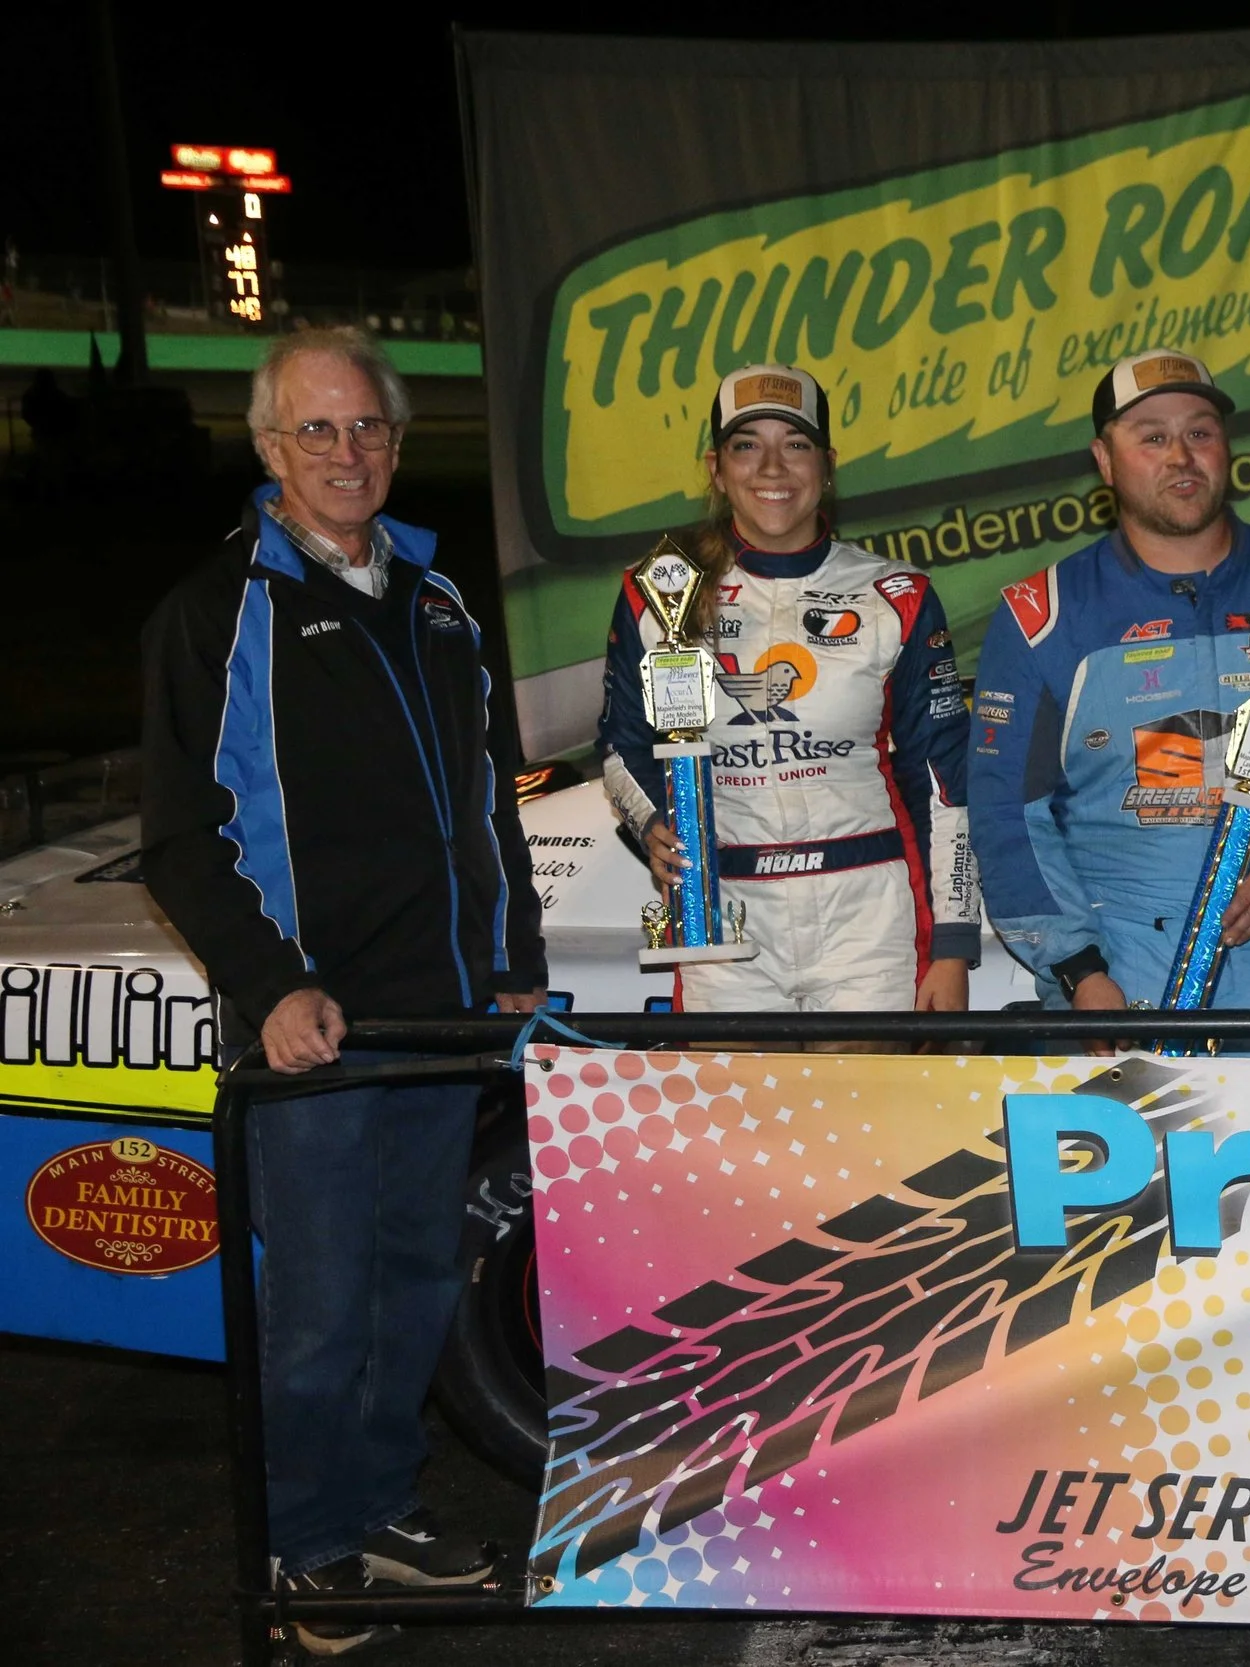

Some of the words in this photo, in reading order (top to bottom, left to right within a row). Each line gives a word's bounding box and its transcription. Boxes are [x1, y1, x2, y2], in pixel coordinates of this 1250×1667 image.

[588, 205, 1066, 408] THUNDER
[988, 317, 1036, 427] of
[1120, 618, 1174, 643] ACT
[660, 719, 676, 728] 3rd
[678, 718, 702, 727] Place
[713, 729, 856, 769] astRise
[715, 773, 767, 787] CREDIT
[778, 766, 828, 782] UNION
[1237, 766, 1250, 777] 1st
[527, 834, 597, 848] Owners:
[755, 851, 824, 874] HOAR
[948, 832, 967, 902] Laplante's
[117, 1141, 151, 1158] 152
[48, 1150, 105, 1179] MAIN
[157, 1155, 217, 1195] STREET
[76, 1181, 188, 1212] FAMILY
[43, 1206, 218, 1243] DENTISTRY
[996, 1469, 1129, 1536] JET
[1012, 1541, 1249, 1615] Envelope
